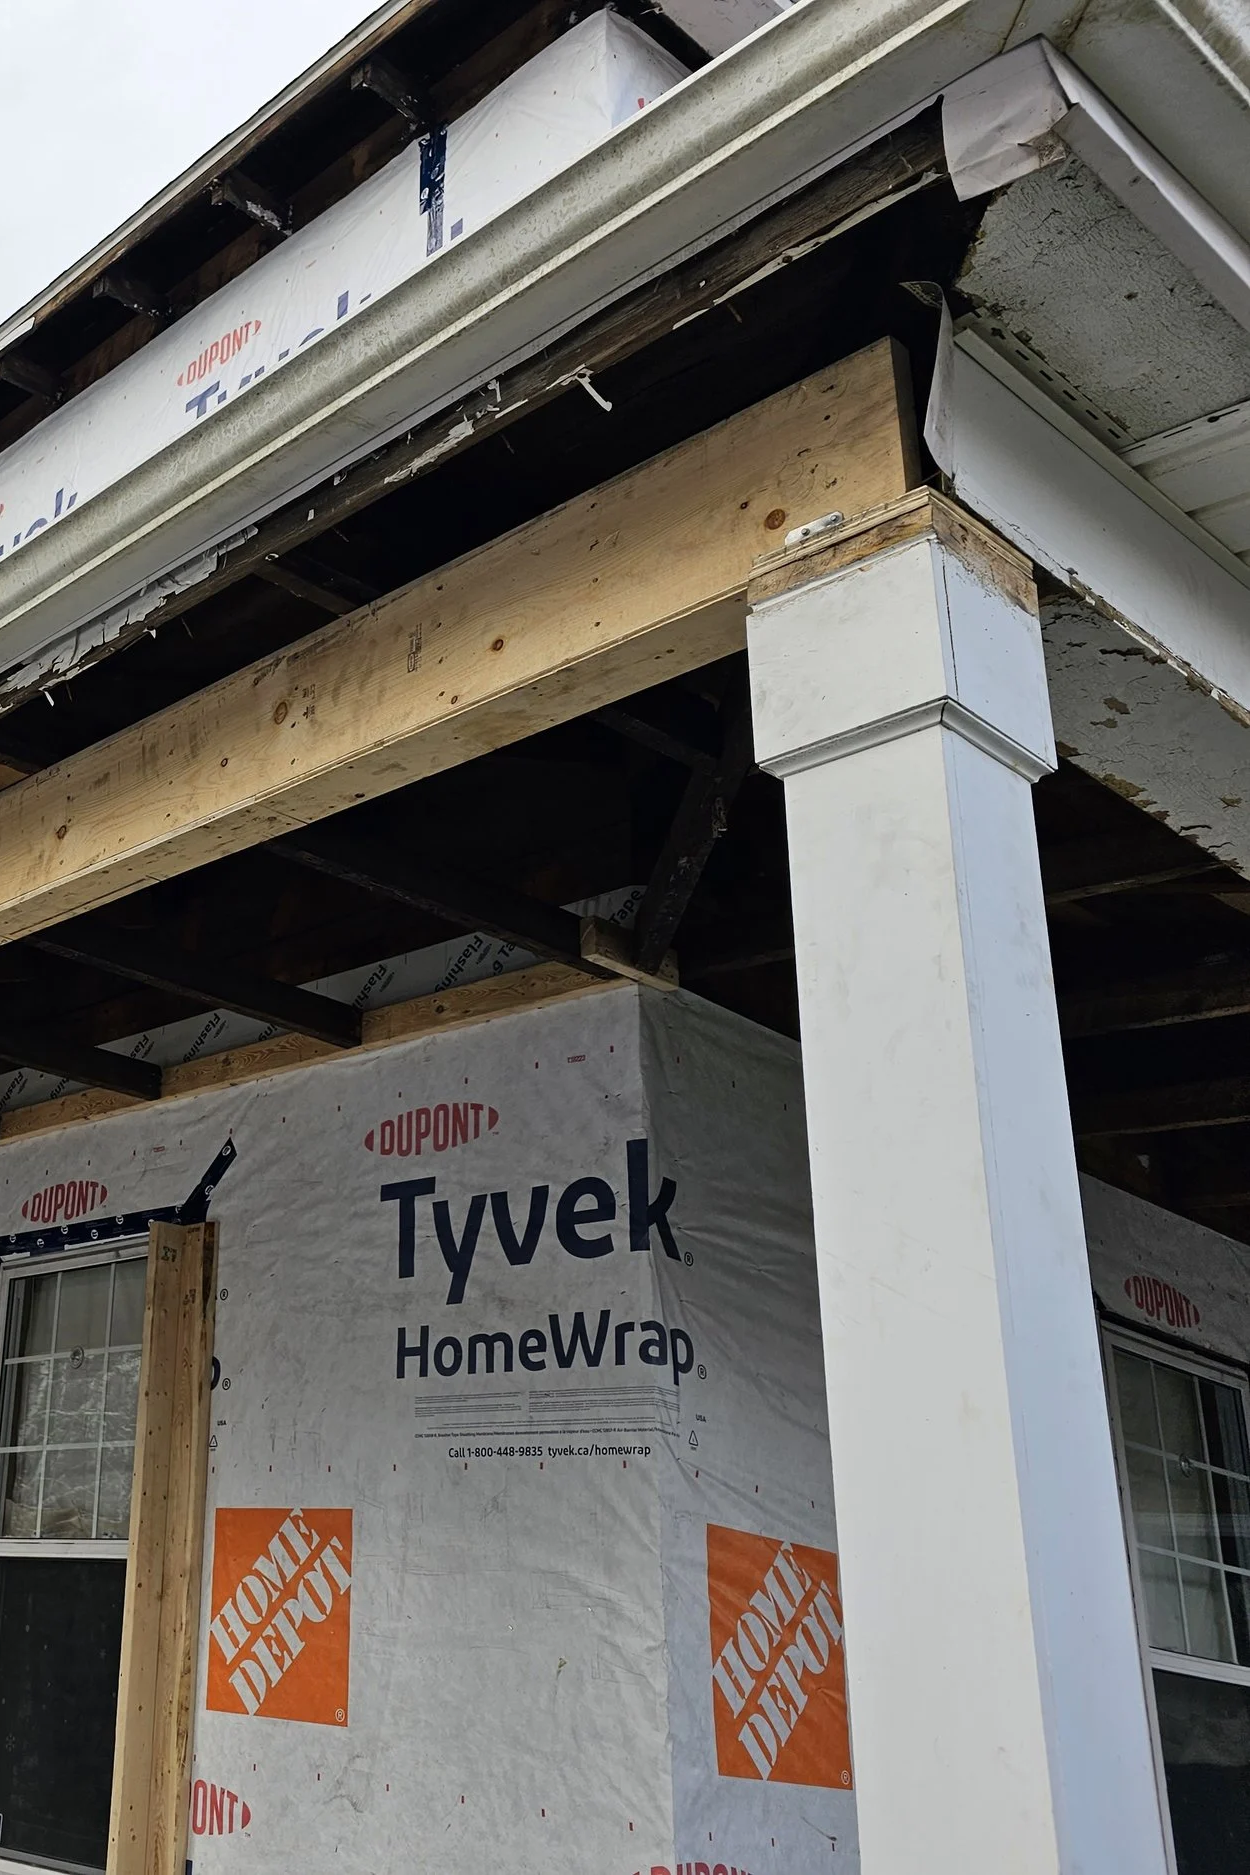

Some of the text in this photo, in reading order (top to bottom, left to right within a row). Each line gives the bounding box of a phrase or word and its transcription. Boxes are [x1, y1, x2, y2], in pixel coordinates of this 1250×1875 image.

[187, 321, 252, 385] DUPONT
[380, 1102, 485, 1157] DUPONT
[30, 1180, 99, 1224] DUPONT
[380, 1138, 682, 1306] Tyvek
[1133, 1275, 1192, 1328] DUPONT
[396, 1309, 695, 1386] HomeWrap
[448, 1444, 651, 1458] Call 1-800-448-9835 tyvek.ca/homewrap
[209, 1506, 320, 1665] HOME
[229, 1536, 352, 1716] DEPOT
[711, 1541, 812, 1719] HOME
[738, 1580, 845, 1781] DEPOT
